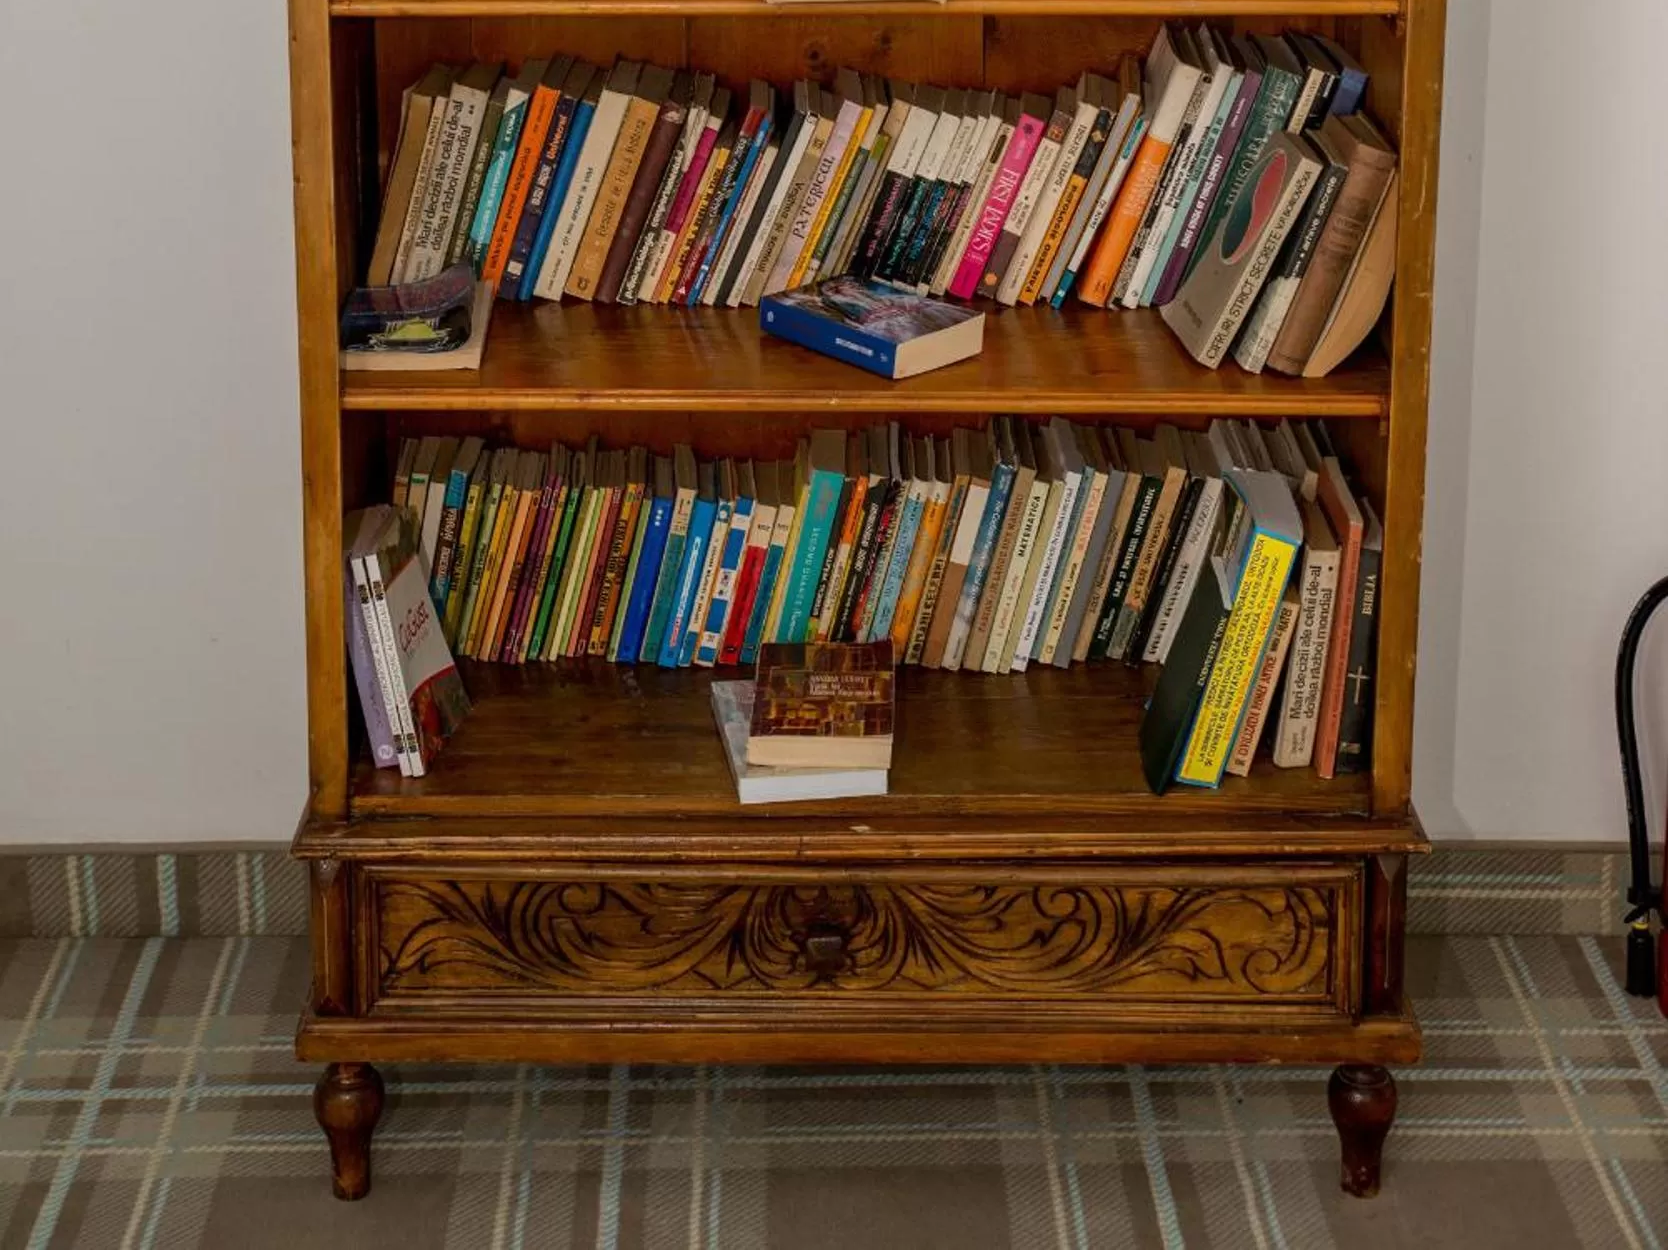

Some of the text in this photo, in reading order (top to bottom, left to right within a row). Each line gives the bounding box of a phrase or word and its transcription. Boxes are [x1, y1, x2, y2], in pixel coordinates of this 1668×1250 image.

[415, 99, 464, 248] Mari decizii ale celui de-al
[429, 213, 448, 251] doilea
[448, 123, 472, 175] mondial
[968, 166, 1021, 253] FIRST LADIES
[1313, 175, 1338, 216] secrete
[1204, 316, 1235, 360] CIFRURI
[1227, 279, 1256, 318] STRICT
[1247, 229, 1283, 280] SECRETE
[1017, 494, 1041, 557] MATEMATICA
[1289, 564, 1321, 719] Mari decizii ale celui de-al
[1303, 587, 1332, 719] doilea război mondial
[1360, 572, 1377, 615] BIBLIA
